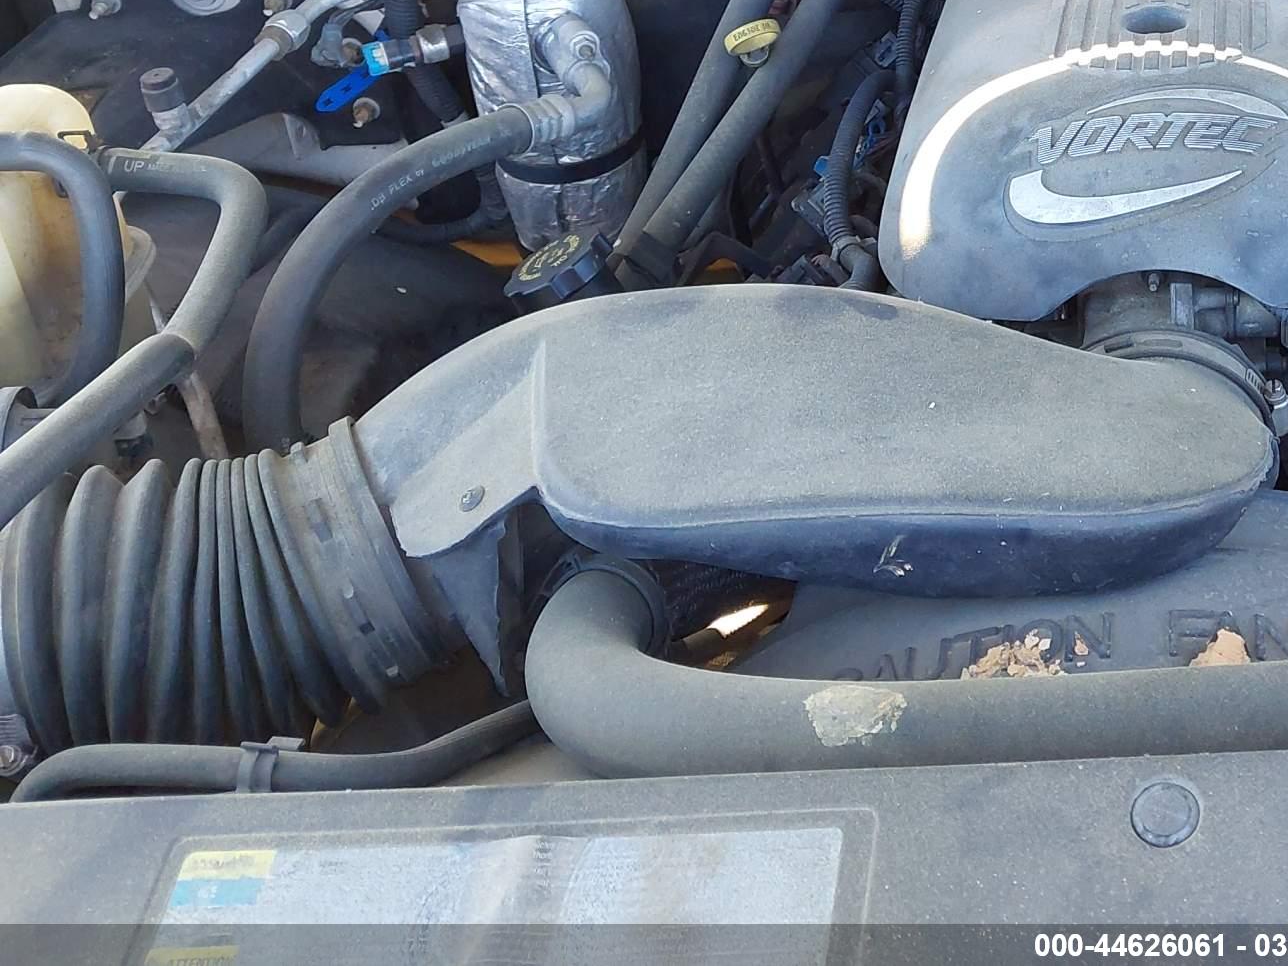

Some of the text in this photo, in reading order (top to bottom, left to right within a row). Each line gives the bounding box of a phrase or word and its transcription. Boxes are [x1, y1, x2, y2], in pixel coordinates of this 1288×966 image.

[1032, 111, 1281, 165] VORTEC
[123, 159, 145, 173] UP
[388, 174, 413, 194] FLEX
[833, 610, 1114, 681] AUTON
